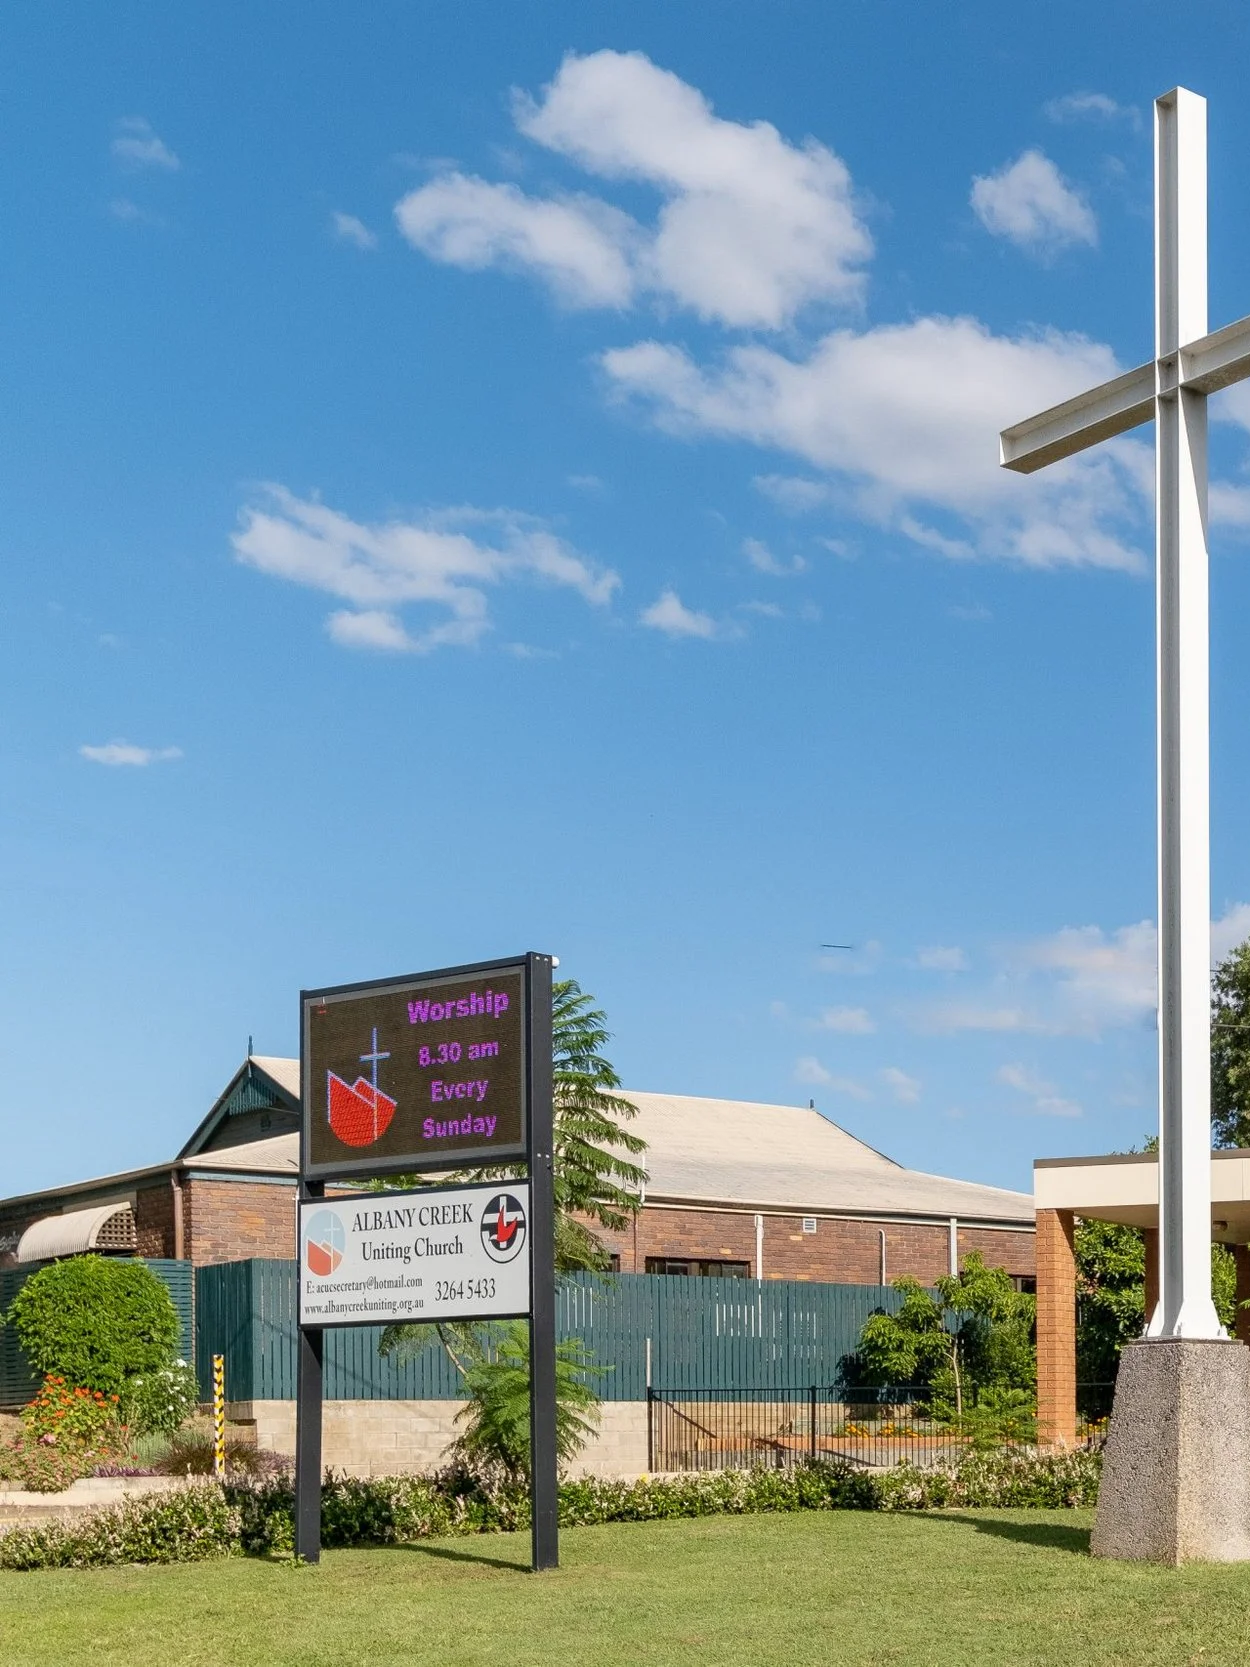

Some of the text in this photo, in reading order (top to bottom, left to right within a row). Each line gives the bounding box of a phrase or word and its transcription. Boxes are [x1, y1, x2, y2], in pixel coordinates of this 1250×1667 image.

[407, 989, 510, 1024] Worship
[418, 1041, 499, 1068] 8.30 am
[431, 1079, 489, 1102] Every
[422, 1113, 497, 1139] Sunday
[352, 1203, 474, 1232] ALBANY CREEK
[362, 1236, 463, 1264] Uniting Church
[306, 1280, 315, 1294] E:
[435, 1278, 496, 1301] 3264 5433
[304, 1298, 424, 1317] www.albanycreekuniting.org.au
